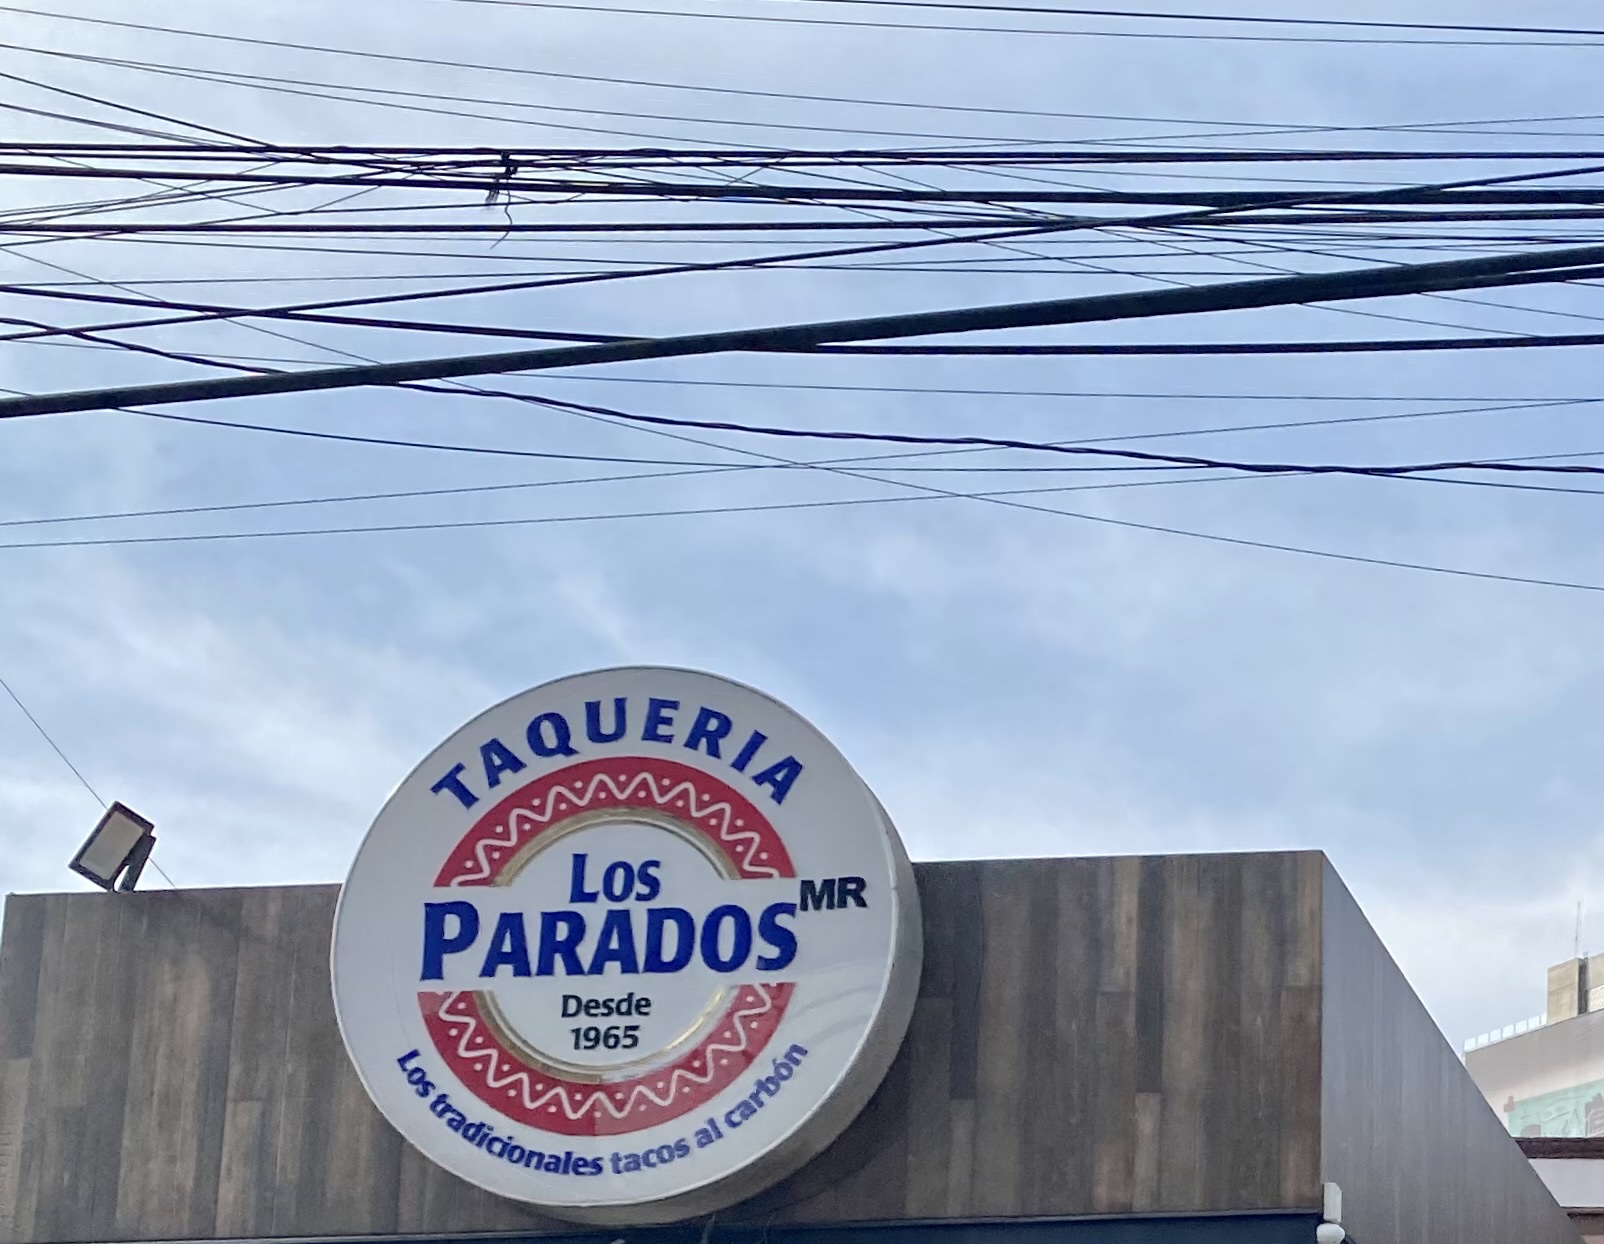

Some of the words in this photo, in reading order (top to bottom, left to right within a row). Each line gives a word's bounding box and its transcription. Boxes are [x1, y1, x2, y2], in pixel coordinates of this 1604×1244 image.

[430, 696, 804, 811] TAQUERIA
[800, 876, 868, 912] MR
[419, 900, 799, 982] PARADOS
[561, 994, 652, 1018] Desde
[570, 1025, 640, 1050] 1965
[396, 1048, 436, 1099] Los
[431, 1092, 604, 1176] tradicionales
[610, 1140, 690, 1174] tacos
[694, 1118, 726, 1150] al
[724, 1042, 808, 1130] carbón
